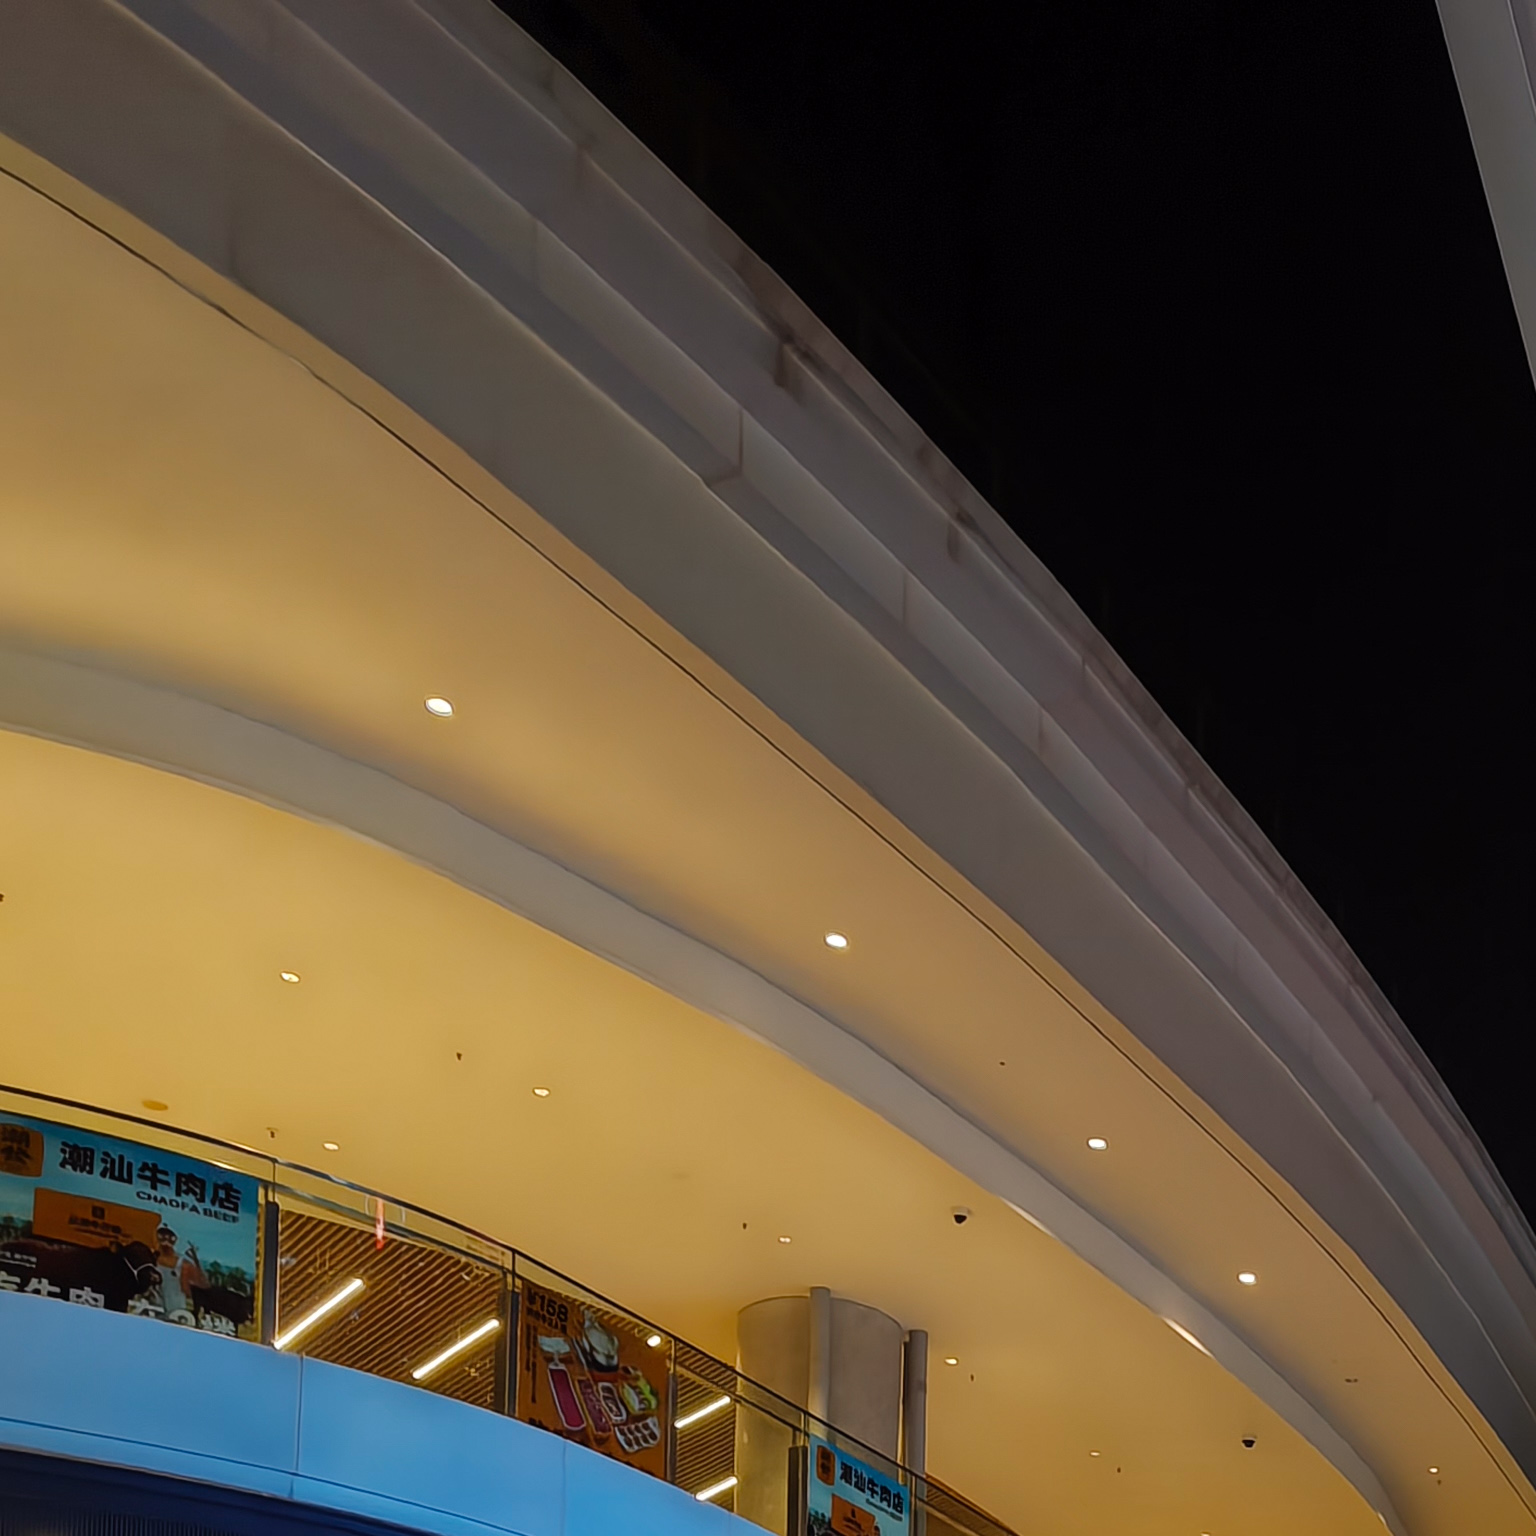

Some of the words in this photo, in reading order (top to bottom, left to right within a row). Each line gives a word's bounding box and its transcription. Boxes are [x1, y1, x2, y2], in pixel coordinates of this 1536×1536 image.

[58, 1140, 242, 1215] 潮汕牛肉店
[839, 1460, 904, 1515] 潮汕牛肉店
